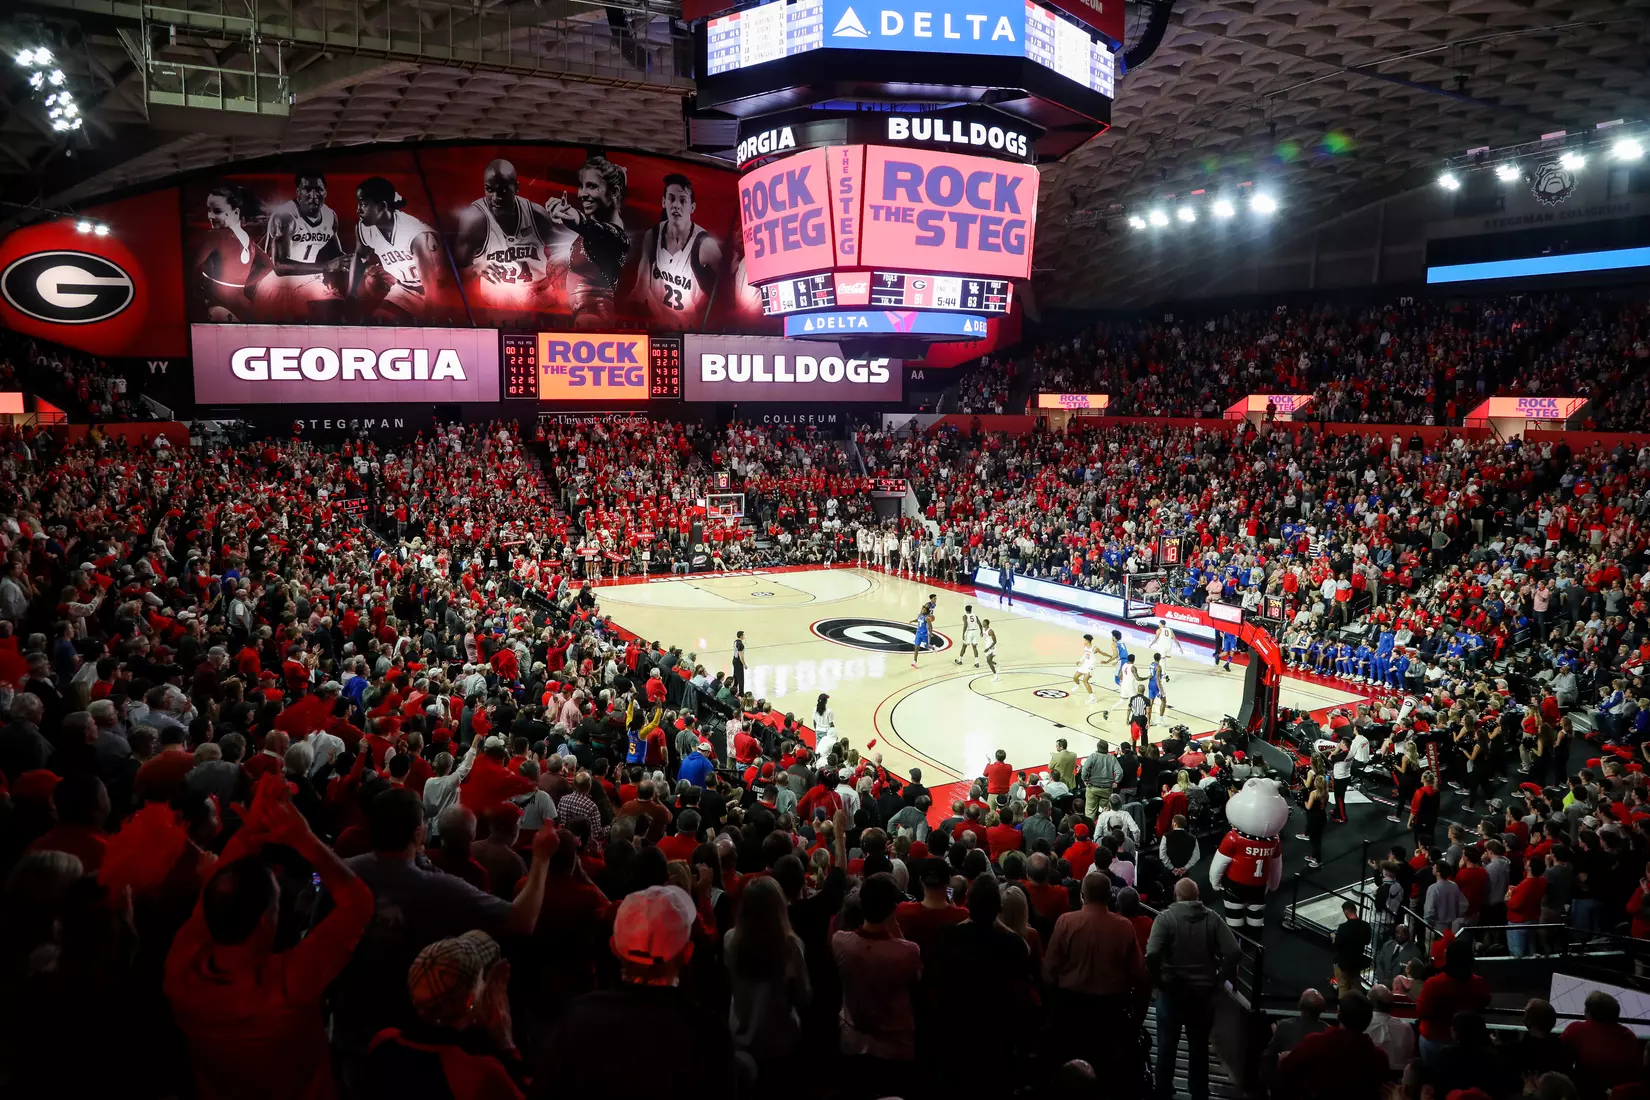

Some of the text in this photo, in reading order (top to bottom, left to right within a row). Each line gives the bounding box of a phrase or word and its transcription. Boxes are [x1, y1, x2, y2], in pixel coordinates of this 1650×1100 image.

[881, 10, 1015, 42] DELTA
[888, 117, 1027, 157] BULLDOGS
[882, 160, 1023, 215] ROCK
[742, 164, 815, 225] ROCK
[753, 207, 827, 259] STEG
[869, 204, 1027, 256] THE STEG
[292, 232, 331, 243] GEORGIA
[303, 245, 312, 260] 1
[499, 263, 533, 284] 24
[663, 285, 684, 311] 23
[937, 297, 957, 307] 5:44
[816, 316, 869, 329] DELTA
[506, 346, 516, 355] 00
[529, 347, 535, 355] 0
[548, 340, 639, 364] ROCK
[652, 349, 678, 357] 00 3 10
[230, 345, 468, 382] GEORGIA
[510, 356, 535, 365] 2 2 10
[656, 358, 661, 366] 3
[662, 358, 668, 366] 2
[147, 360, 169, 375] YY
[529, 366, 535, 375] 5
[663, 368, 668, 376] 3
[671, 368, 678, 376] 13
[700, 353, 890, 384] BULLDOGS
[511, 376, 516, 384] 5
[518, 376, 524, 384] 2
[542, 365, 645, 387] THE STEG
[656, 377, 661, 385] 5
[671, 377, 678, 385] 10
[911, 370, 925, 381] AA
[509, 386, 517, 394] 10
[518, 386, 524, 394] 2
[652, 386, 678, 394] 23 2 2
[1518, 398, 1557, 408] ROCK
[1525, 408, 1559, 418] STEG
[296, 419, 404, 429] STEGMAN
[1167, 547, 1177, 562] 18
[1270, 599, 1282, 607] 5:44
[969, 615, 975, 623] 5
[1164, 629, 1169, 637] 0
[629, 742, 636, 755] 5
[1254, 859, 1264, 878] 1
